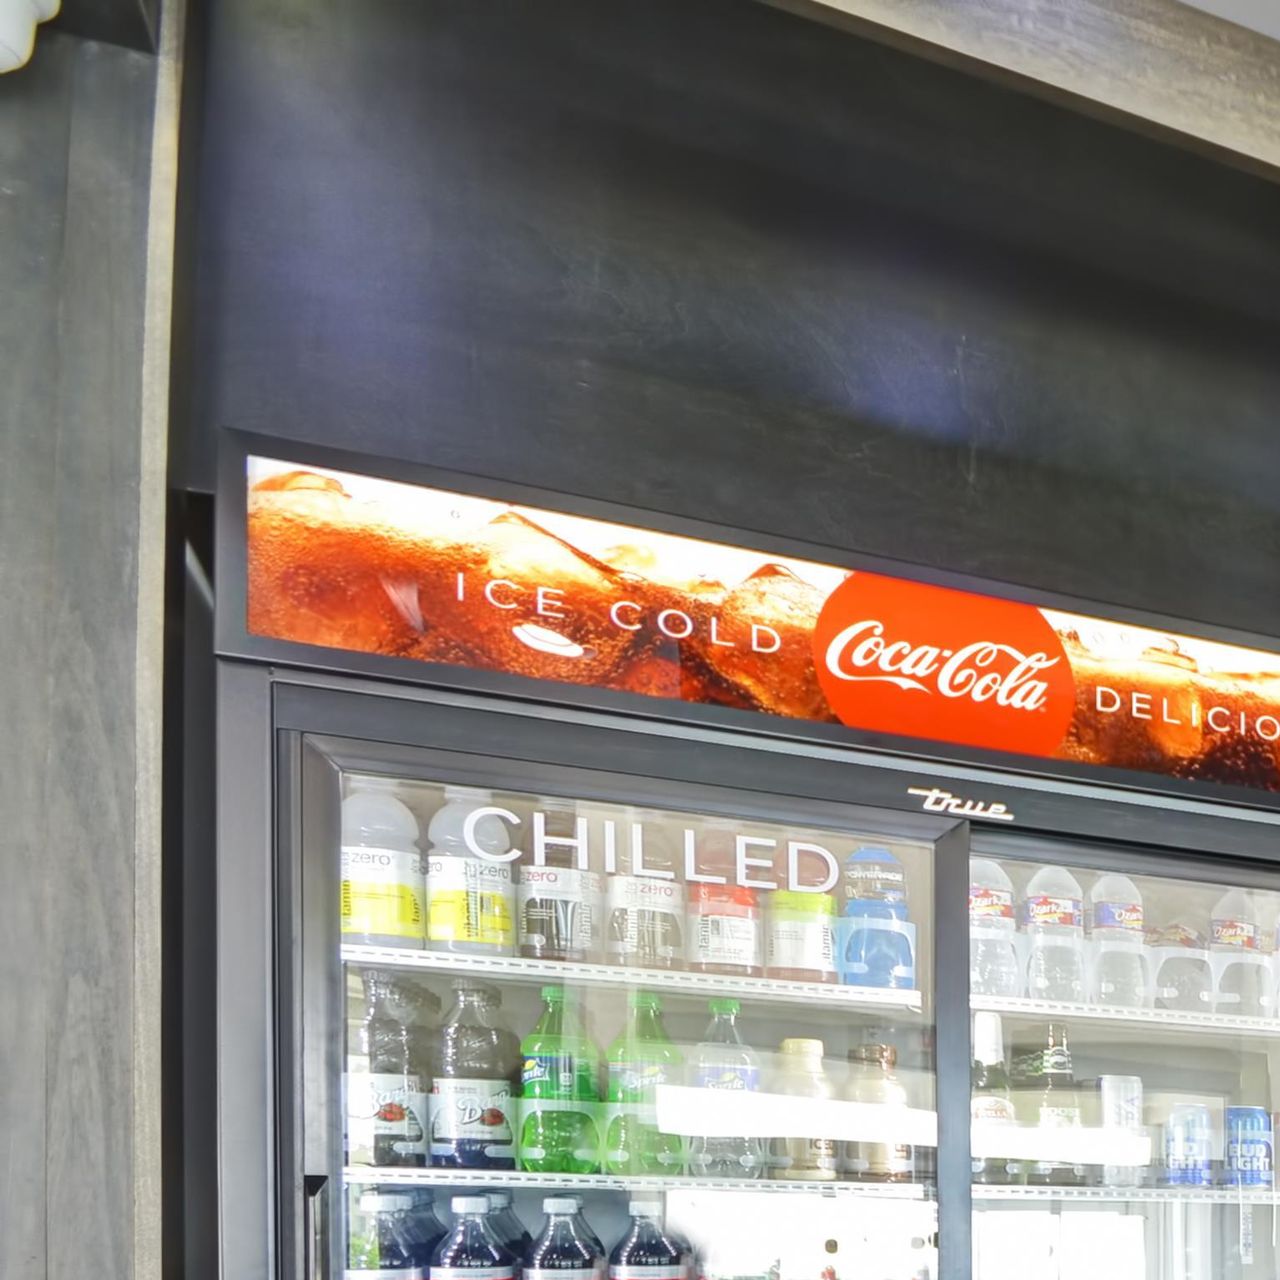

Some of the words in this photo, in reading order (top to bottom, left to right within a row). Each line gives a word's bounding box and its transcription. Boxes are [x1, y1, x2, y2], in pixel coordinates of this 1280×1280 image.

[456, 572, 565, 619] ICE
[610, 599, 782, 655] COLD
[825, 620, 1060, 713] Coca-Cola
[464, 806, 839, 894] CHILLED
[352, 851, 391, 867] zero
[480, 863, 510, 880] zero
[526, 870, 558, 883] zero
[640, 882, 674, 897] zero
[1228, 1143, 1267, 1157] BUD
[1225, 1156, 1271, 1172] LIGHT
